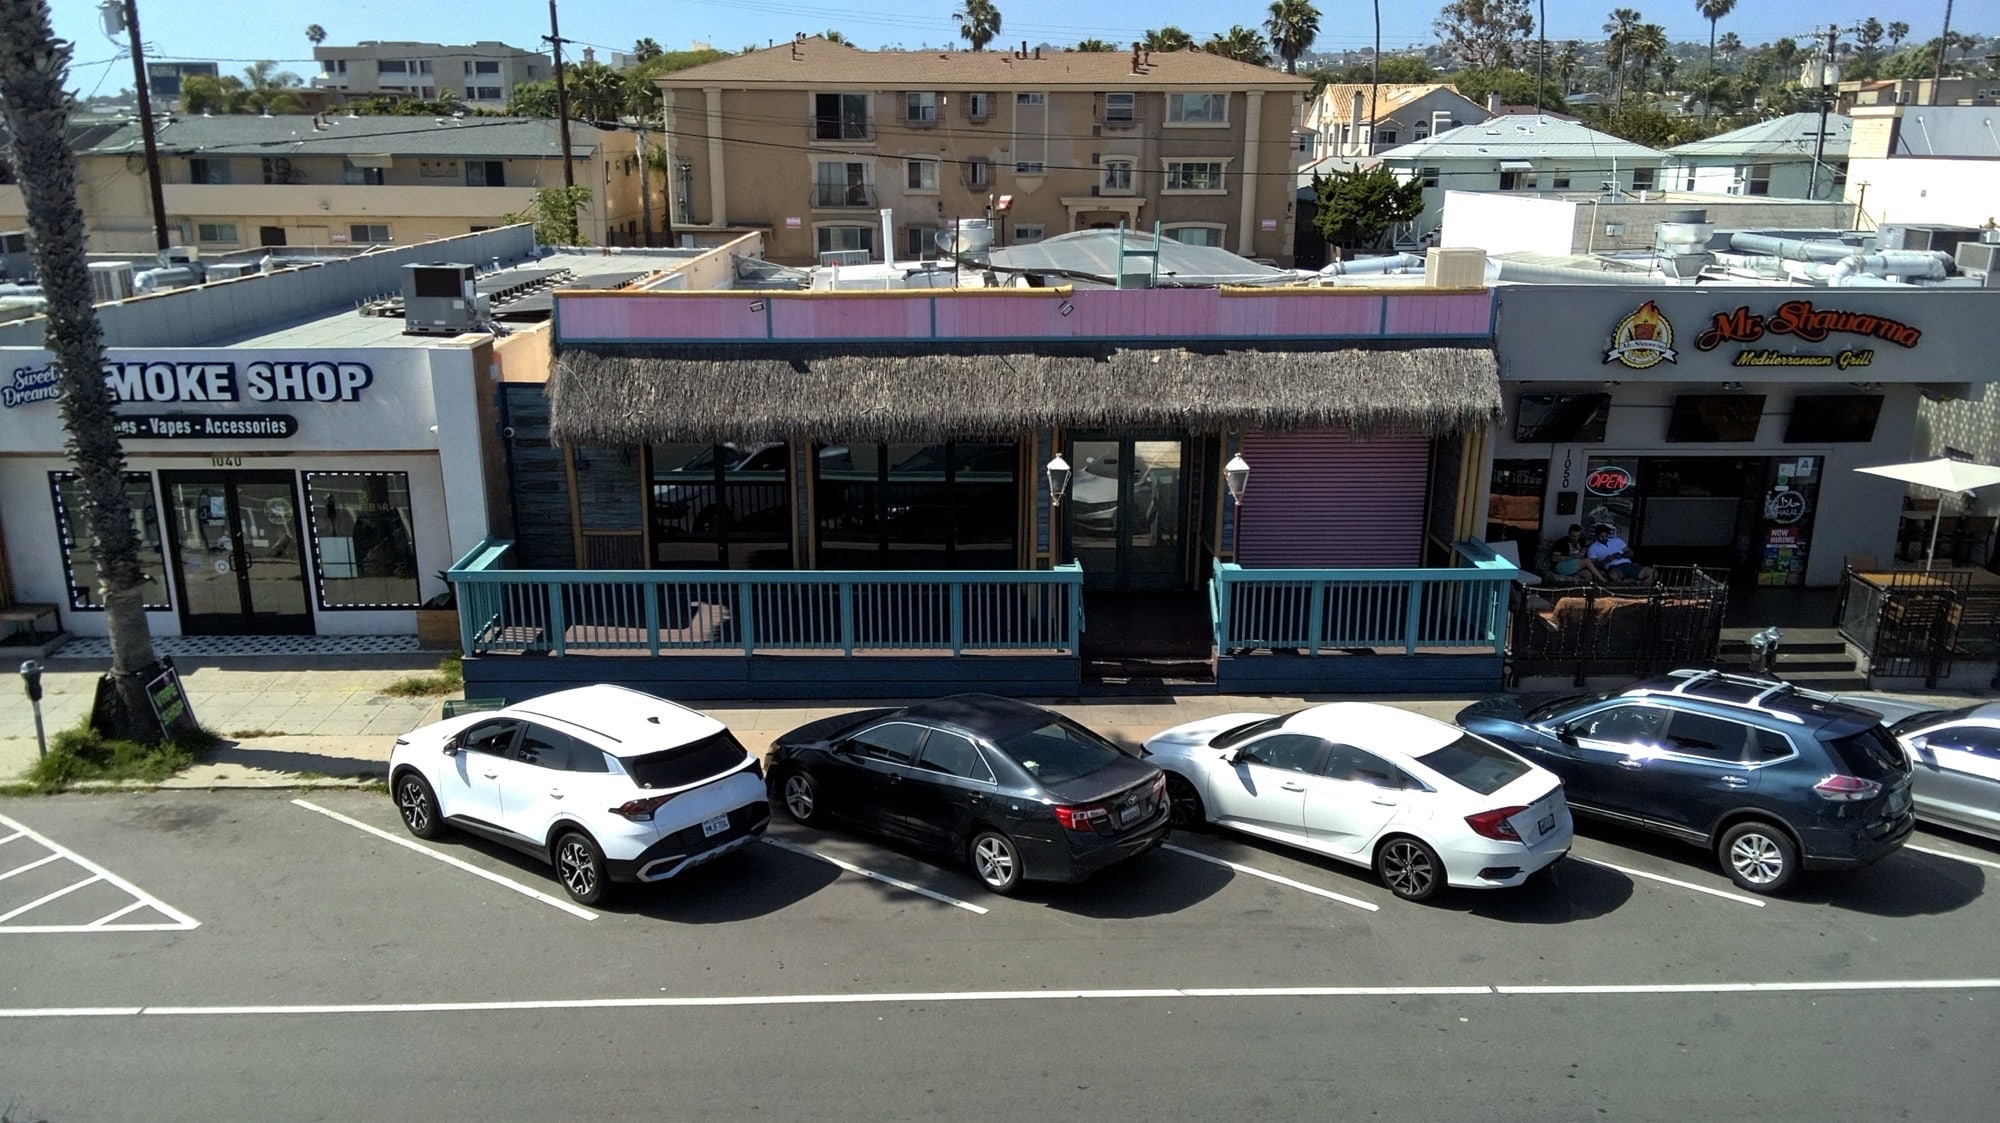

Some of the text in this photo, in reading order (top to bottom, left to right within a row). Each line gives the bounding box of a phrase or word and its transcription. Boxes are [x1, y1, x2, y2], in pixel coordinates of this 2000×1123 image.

[1768, 301, 1921, 347] Shawarma
[1736, 350, 1873, 370] Mediterranean Grill
[14, 366, 57, 390] Sweet
[103, 361, 371, 402] MOKE SHOP
[2, 385, 60, 407] Dreams
[150, 419, 191, 437] Vapes
[205, 417, 287, 434] Accessories
[1562, 449, 1571, 488] 1050
[1588, 473, 1628, 489] OPEN
[1769, 536, 1796, 544] HIRING
[1771, 529, 1789, 537] NOW
